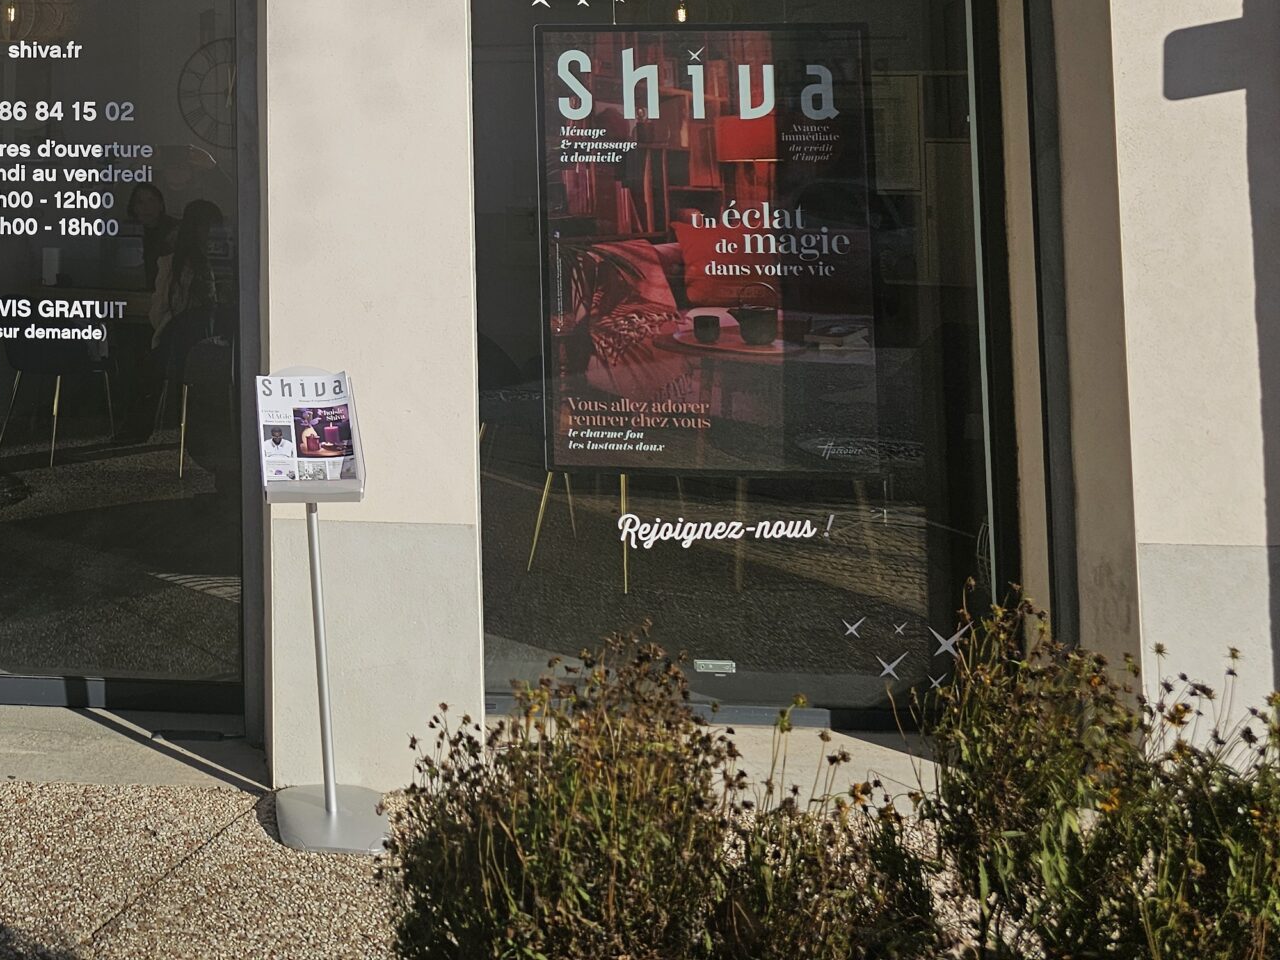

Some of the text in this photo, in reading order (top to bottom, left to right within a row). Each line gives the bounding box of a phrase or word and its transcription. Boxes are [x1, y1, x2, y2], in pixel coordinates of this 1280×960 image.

[8, 40, 82, 58] shiva.fr
[35, 101, 64, 121] 84
[72, 101, 97, 121] 15
[105, 102, 134, 121] 02
[560, 126, 606, 139] Ménage
[781, 132, 840, 141] immédiate
[792, 124, 830, 132] Avance
[37, 139, 153, 158] d'ouverture
[560, 139, 637, 152] & repassage
[560, 152, 622, 162] à domicile
[32, 168, 57, 182] au
[63, 165, 153, 182] vendredi
[54, 191, 114, 209] 12h00
[691, 200, 806, 230] Un éclat
[59, 217, 119, 236] 18h00
[715, 226, 850, 261] de magie
[705, 261, 835, 276] dans votre vie
[38, 300, 127, 318] GRATUIT
[24, 323, 107, 341] demande)
[568, 397, 710, 414] Vous allez adorer
[568, 413, 711, 429] rentrer chez vous
[568, 429, 644, 441] le charme fou
[568, 441, 665, 452] les instants doux
[618, 513, 835, 549] Rejoignez-nous !
